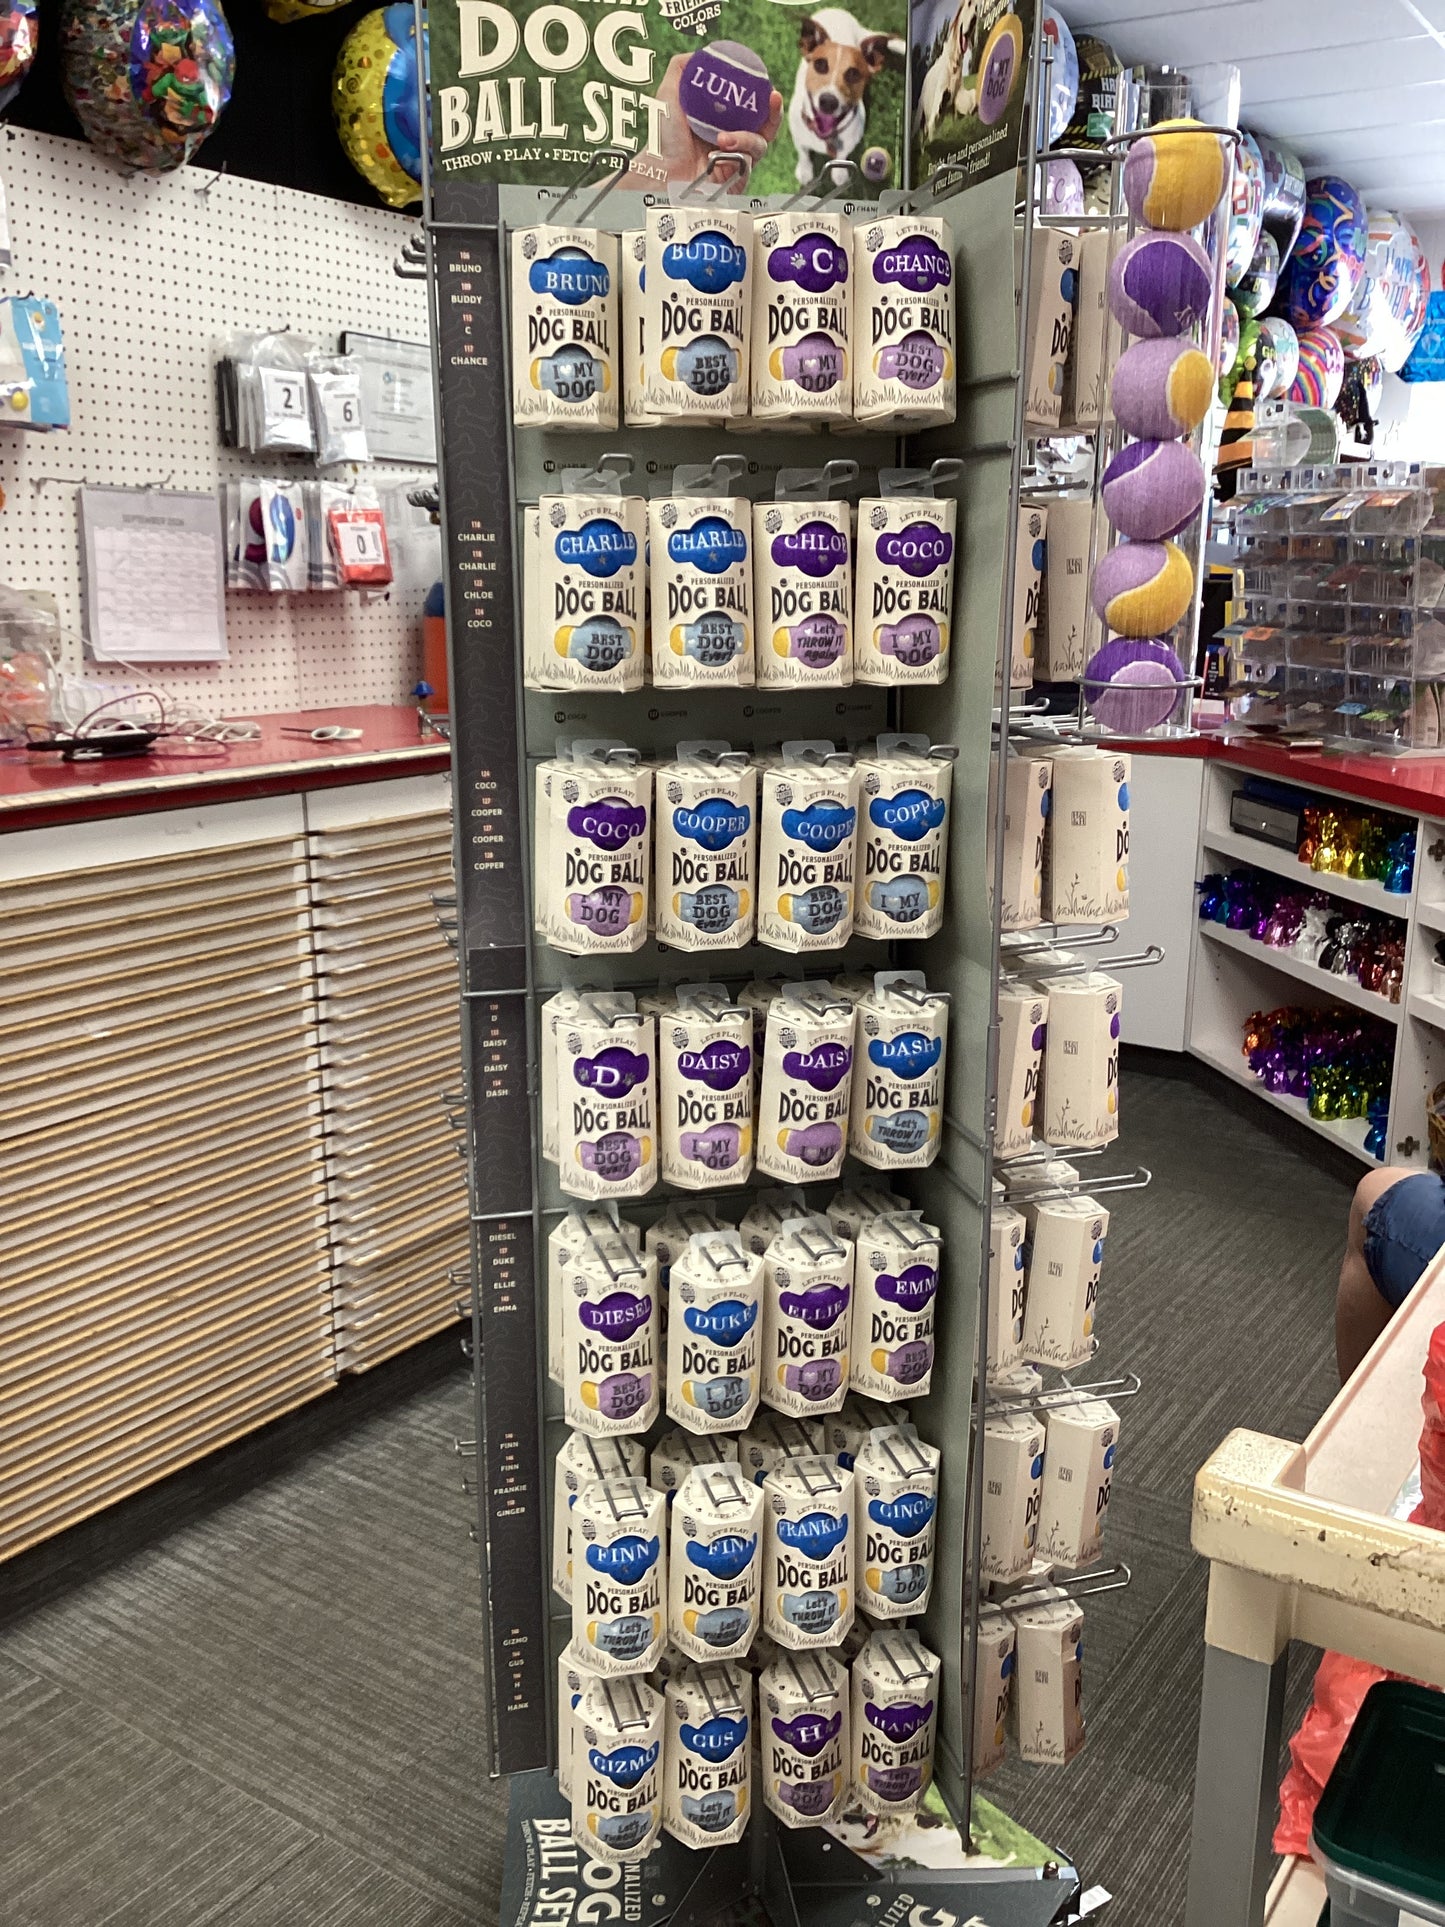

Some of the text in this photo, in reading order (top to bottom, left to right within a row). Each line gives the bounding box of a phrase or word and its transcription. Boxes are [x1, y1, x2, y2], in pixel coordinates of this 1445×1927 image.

[672, 6, 721, 30] COLORS
[458, 1, 655, 85] DOG
[691, 67, 758, 112] LUNA
[439, 77, 670, 160] BALL SET
[957, 144, 968, 161] and
[968, 123, 1008, 159] personalized
[442, 152, 492, 172] THROW
[504, 149, 541, 160] PLAY
[689, 219, 712, 232] LET'S
[714, 220, 736, 234] PLAY!
[792, 222, 839, 236] LET'S PLAY!
[672, 243, 742, 266] BUDDY
[812, 249, 834, 273] C
[449, 264, 482, 273] BRUNO
[883, 255, 950, 278] CHANCE
[451, 295, 482, 304] BUDDY
[465, 326, 471, 334] C
[662, 300, 743, 343] DOG BALL
[768, 304, 848, 345] DOG BALL
[872, 307, 951, 347] DOG BALL
[529, 315, 610, 356] DOG BALL
[451, 357, 487, 365] CHANCE
[574, 362, 593, 378] MY
[818, 354, 837, 370] MY
[895, 353, 934, 372] DOG
[691, 370, 730, 384] DOG
[282, 387, 292, 409] 2
[556, 381, 595, 398] DOG
[343, 401, 352, 422] 6
[559, 530, 635, 555] CHARLIE
[671, 528, 744, 551] CHARLIE
[784, 533, 847, 554] CHLOE
[887, 540, 945, 558] COCO
[555, 582, 637, 621] DOG BALL
[668, 582, 748, 620] DOG BALL
[771, 585, 848, 624] DOG BALL
[873, 582, 948, 619] DOG BALL
[468, 620, 492, 628] COCO
[814, 624, 835, 635] Let's
[697, 636, 736, 649] DOG
[797, 637, 833, 649] THROW
[912, 630, 932, 644] MY
[585, 646, 624, 661] DOG
[583, 817, 640, 839] COCO
[677, 810, 746, 833] COOPER
[797, 815, 855, 840] COOPE
[474, 862, 504, 870] COPPER
[672, 851, 749, 887] DOG BALL
[866, 841, 940, 876] DOG BALL
[566, 852, 644, 888] DOG BALL
[778, 853, 853, 888] DOG BALL
[602, 892, 624, 907] MY
[808, 899, 843, 917] DOG
[900, 892, 921, 908] MY
[581, 906, 620, 924] DOG
[692, 906, 731, 919] DOG
[483, 1039, 507, 1047] DAISY
[882, 1039, 935, 1057] DASH
[484, 1064, 508, 1072] DAISY
[681, 1053, 741, 1070] DAISY
[591, 1065, 620, 1087] D
[486, 1089, 508, 1097] DASH
[866, 1078, 939, 1110] DOG BALL
[573, 1099, 651, 1136] DOG BALL
[678, 1094, 716, 1128] DOG
[778, 1092, 818, 1123] DOG
[711, 1138, 731, 1153] MY
[594, 1151, 632, 1165] DOG
[489, 1233, 516, 1242] DIESEL
[493, 1257, 515, 1265] DUKE
[493, 1281, 516, 1289] ELLIE
[895, 1268, 938, 1294] EMM
[493, 1305, 517, 1313] EMMA
[591, 1298, 651, 1326] DIESEL
[694, 1307, 752, 1331] DUKE
[788, 1300, 843, 1321] ELLIE
[871, 1312, 908, 1343] DOG
[777, 1328, 848, 1358] DOG BALL
[579, 1338, 653, 1374] DOG BALL
[682, 1344, 720, 1375] DOG
[724, 1381, 743, 1398] MY
[501, 1464, 519, 1472] FINN
[494, 1484, 527, 1495] FRANKIE
[497, 1507, 525, 1517] GINGER
[778, 1517, 844, 1538] FRANKIE
[597, 1544, 649, 1562] FINN
[866, 1534, 903, 1564] DOG
[777, 1555, 848, 1589] DOG BALL
[586, 1578, 660, 1615] DOG BALL
[684, 1575, 719, 1606] DOG
[503, 1637, 528, 1646] GIZMO
[509, 1659, 525, 1667] GUS
[692, 1731, 734, 1749] GUS
[797, 1724, 823, 1744] H
[862, 1732, 930, 1766] DOG BALL
[594, 1747, 655, 1774] GIZMO
[773, 1747, 843, 1781] DOG BALL
[679, 1757, 748, 1791] DOG BALL
[587, 1779, 658, 1813] DOG BALL
[577, 1858, 621, 1925] OG
